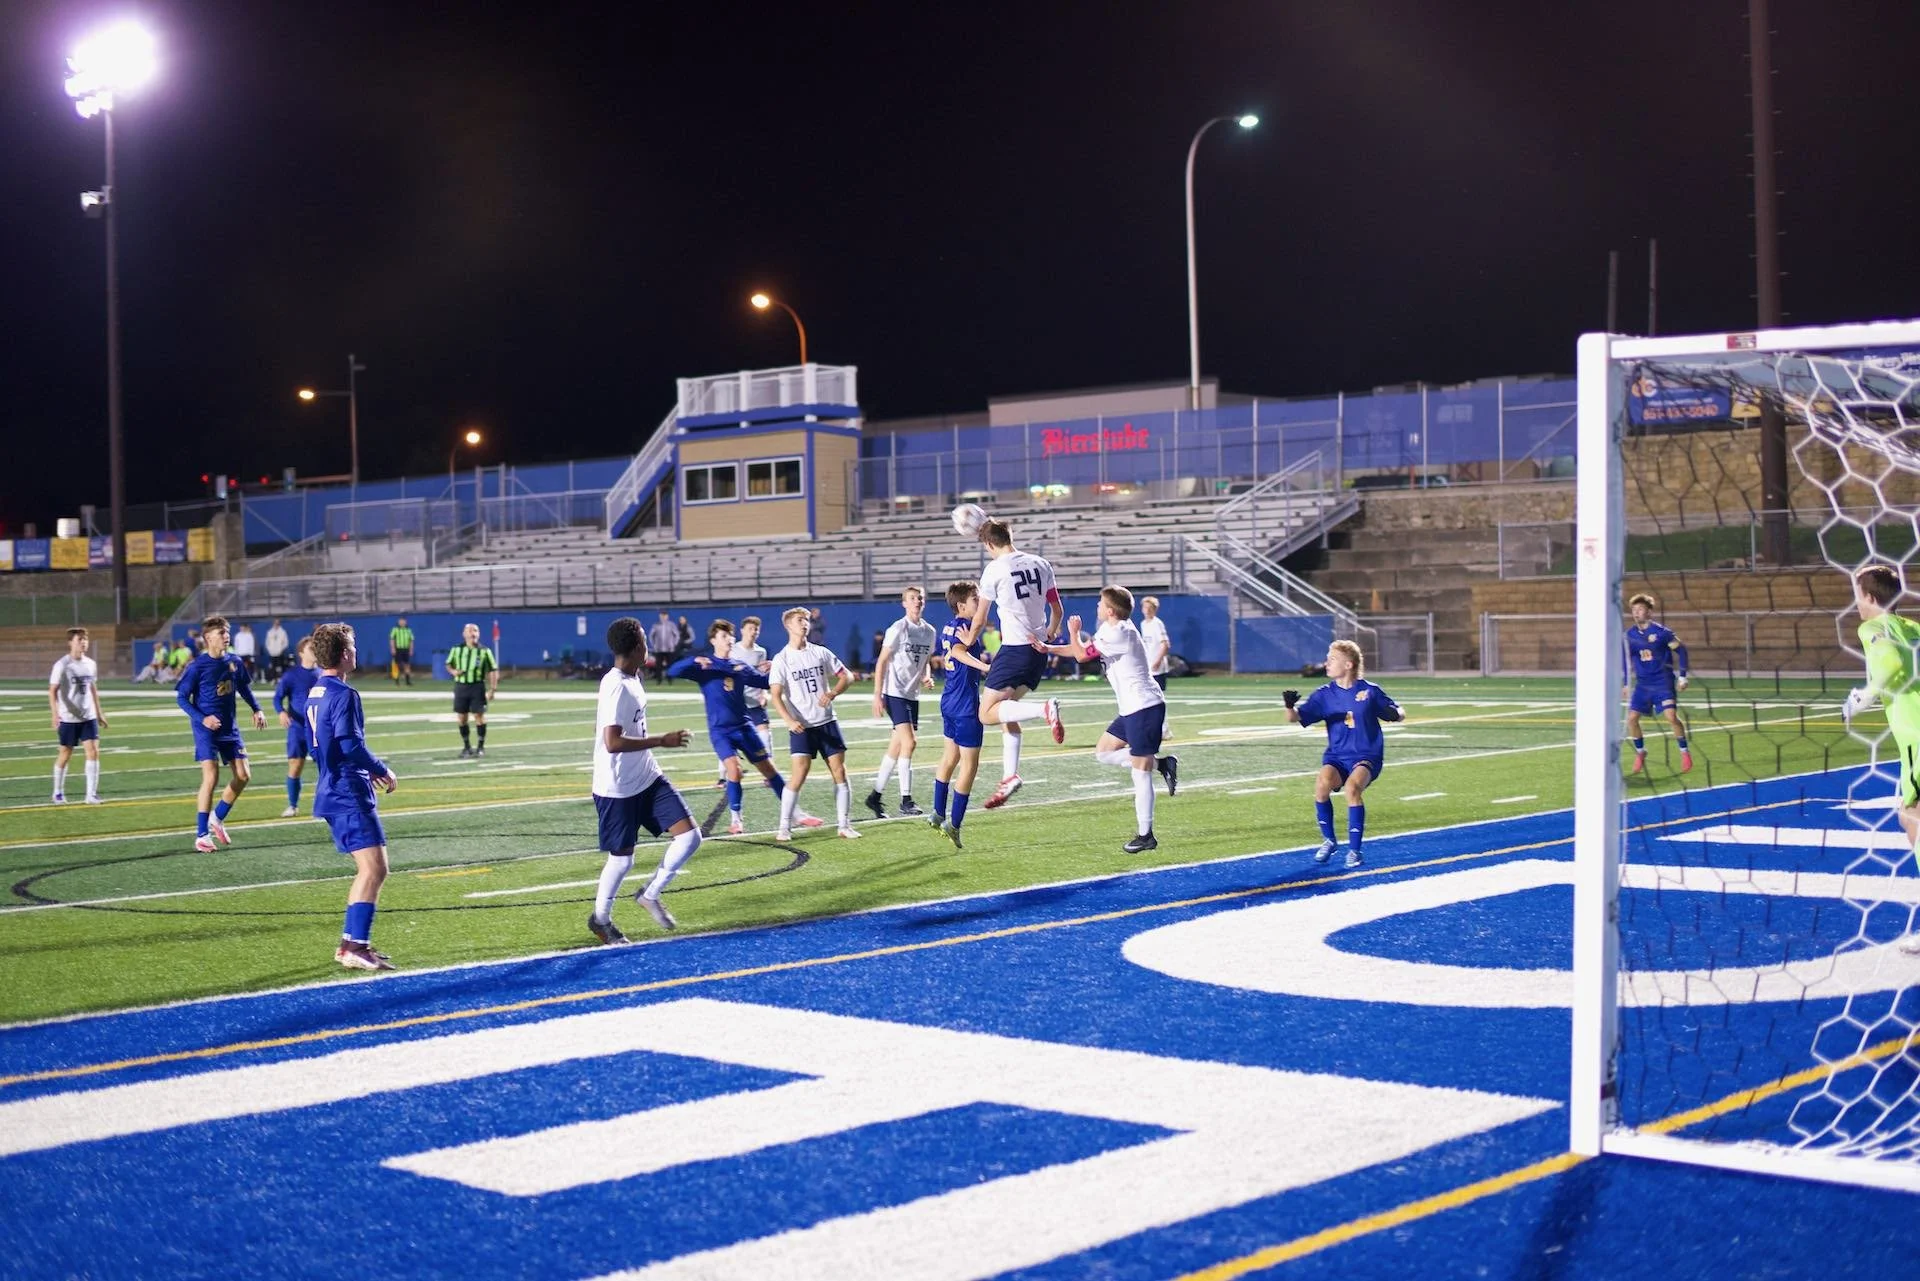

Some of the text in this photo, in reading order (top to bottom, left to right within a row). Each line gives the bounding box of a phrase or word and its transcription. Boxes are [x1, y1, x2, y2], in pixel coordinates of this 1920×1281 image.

[1010, 567, 1042, 600] 24
[792, 665, 825, 682] CADETS
[805, 679, 818, 694] 13
